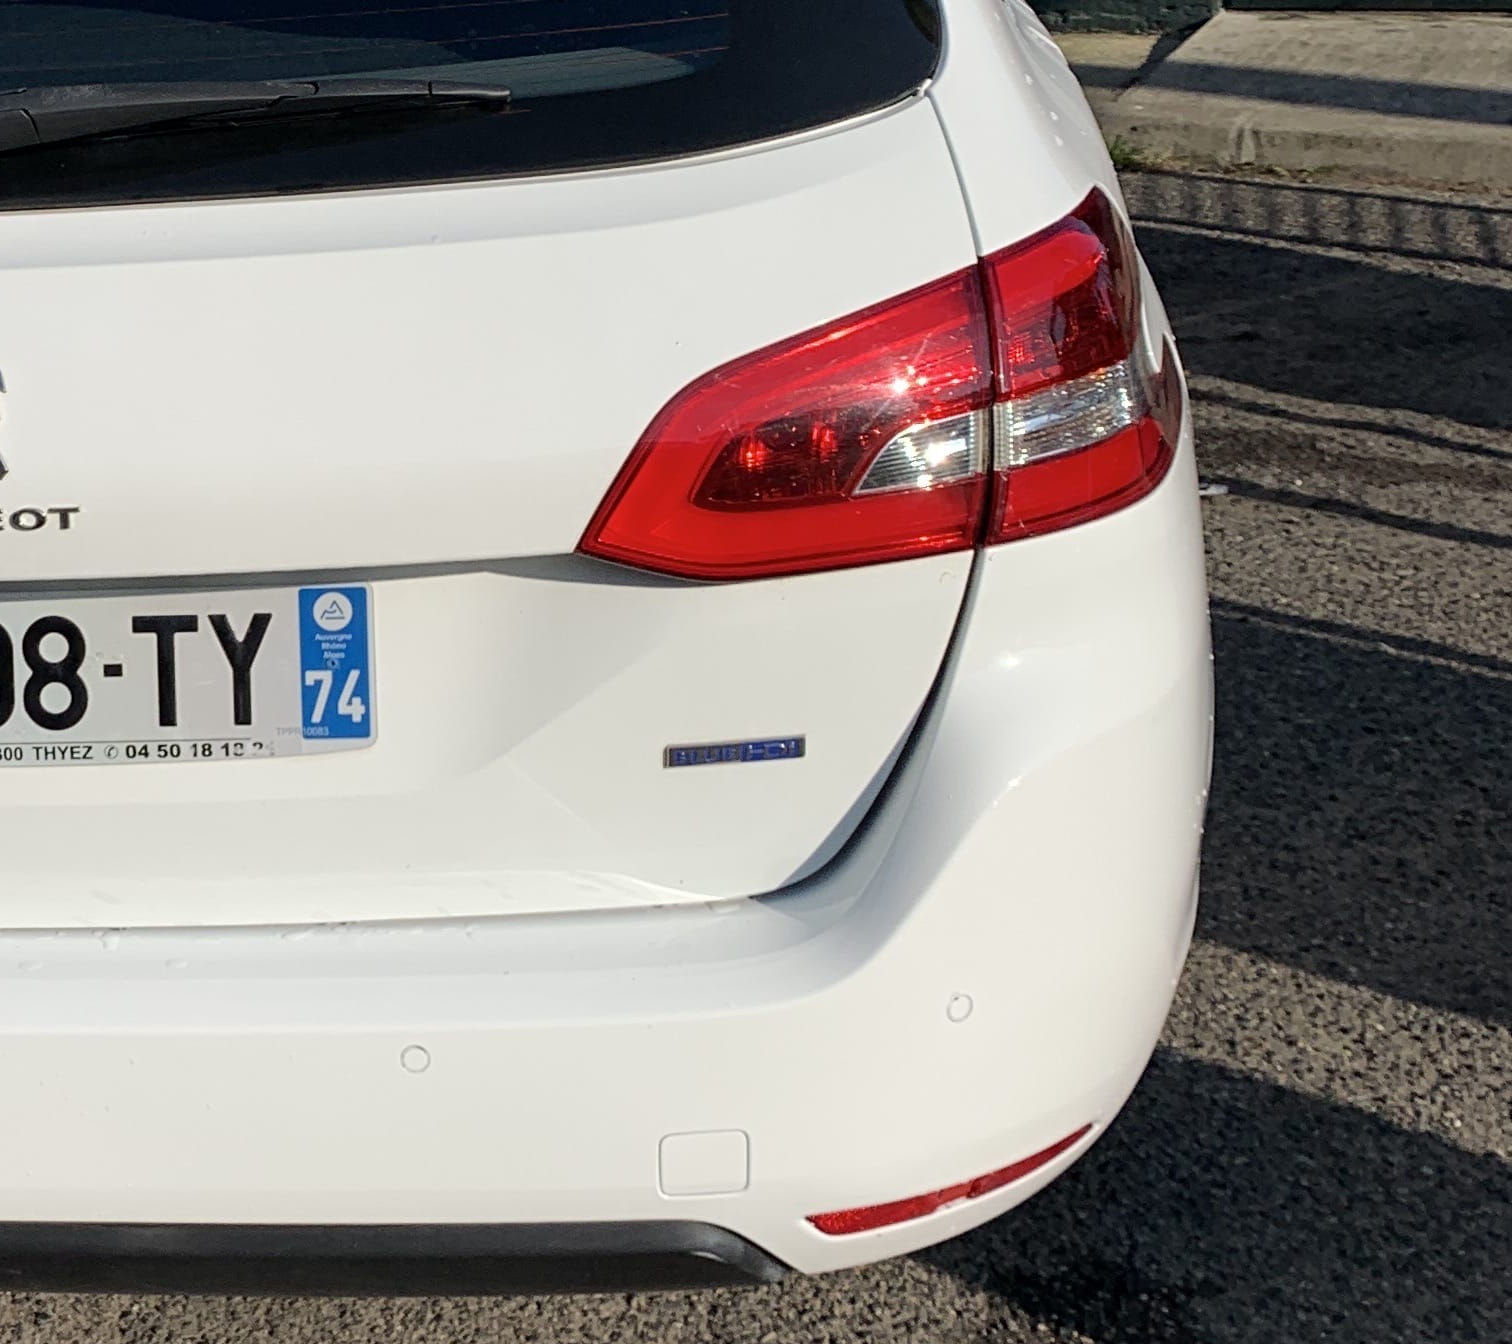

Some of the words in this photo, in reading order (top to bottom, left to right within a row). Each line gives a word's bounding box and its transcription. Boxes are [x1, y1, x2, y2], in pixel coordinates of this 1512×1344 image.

[304, 669, 366, 724] 74
[33, 745, 94, 760] THYEZ
[125, 743, 149, 759] 04
[157, 743, 182, 758] 50
[190, 742, 213, 757] 18
